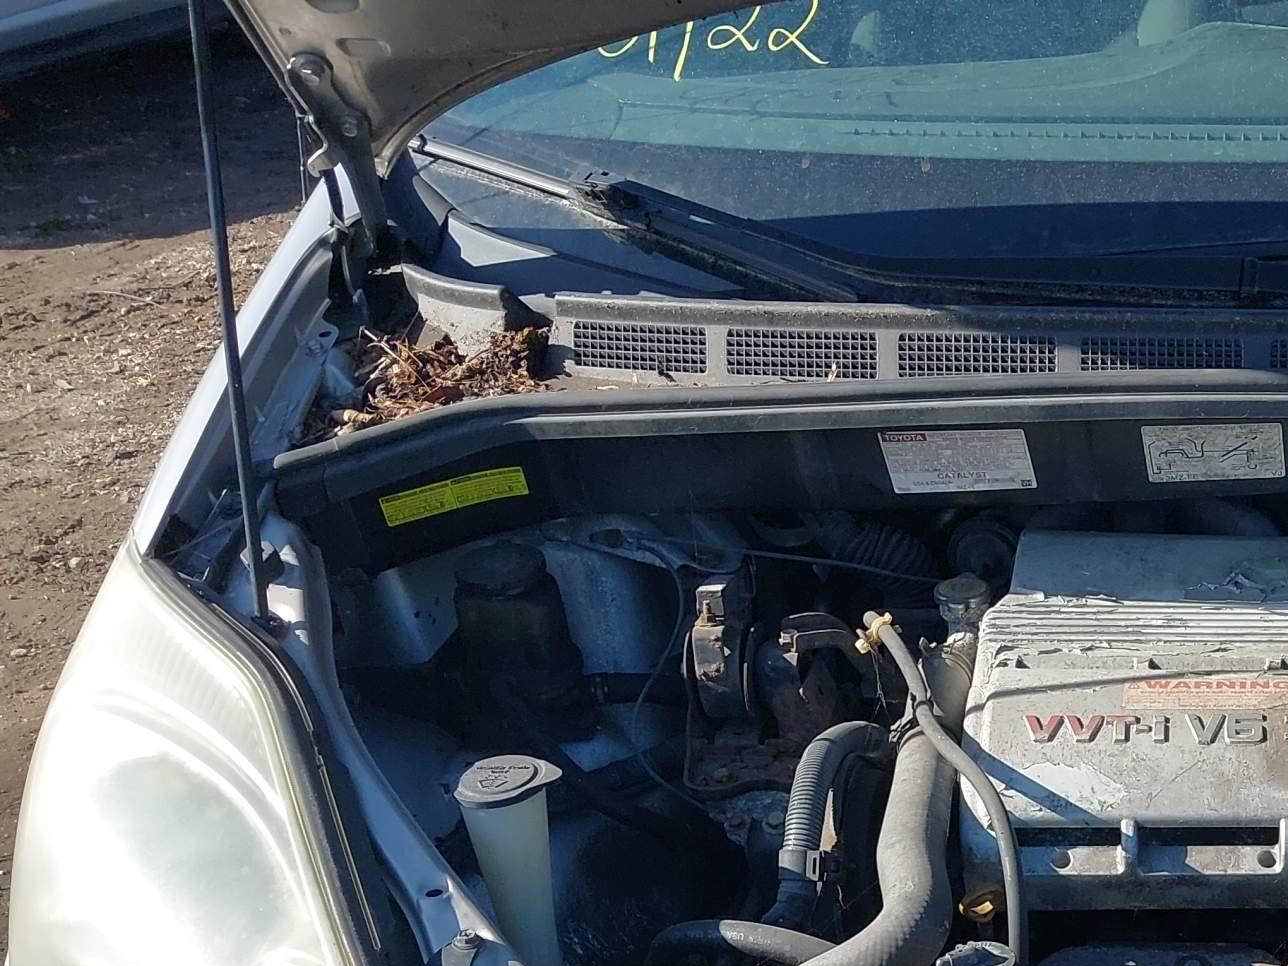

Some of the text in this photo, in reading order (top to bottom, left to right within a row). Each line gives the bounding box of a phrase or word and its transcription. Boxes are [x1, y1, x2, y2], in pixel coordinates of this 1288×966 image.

[884, 433, 924, 442] TOYOTA
[936, 471, 987, 480] CATALYST
[1184, 713, 1268, 745] V6
